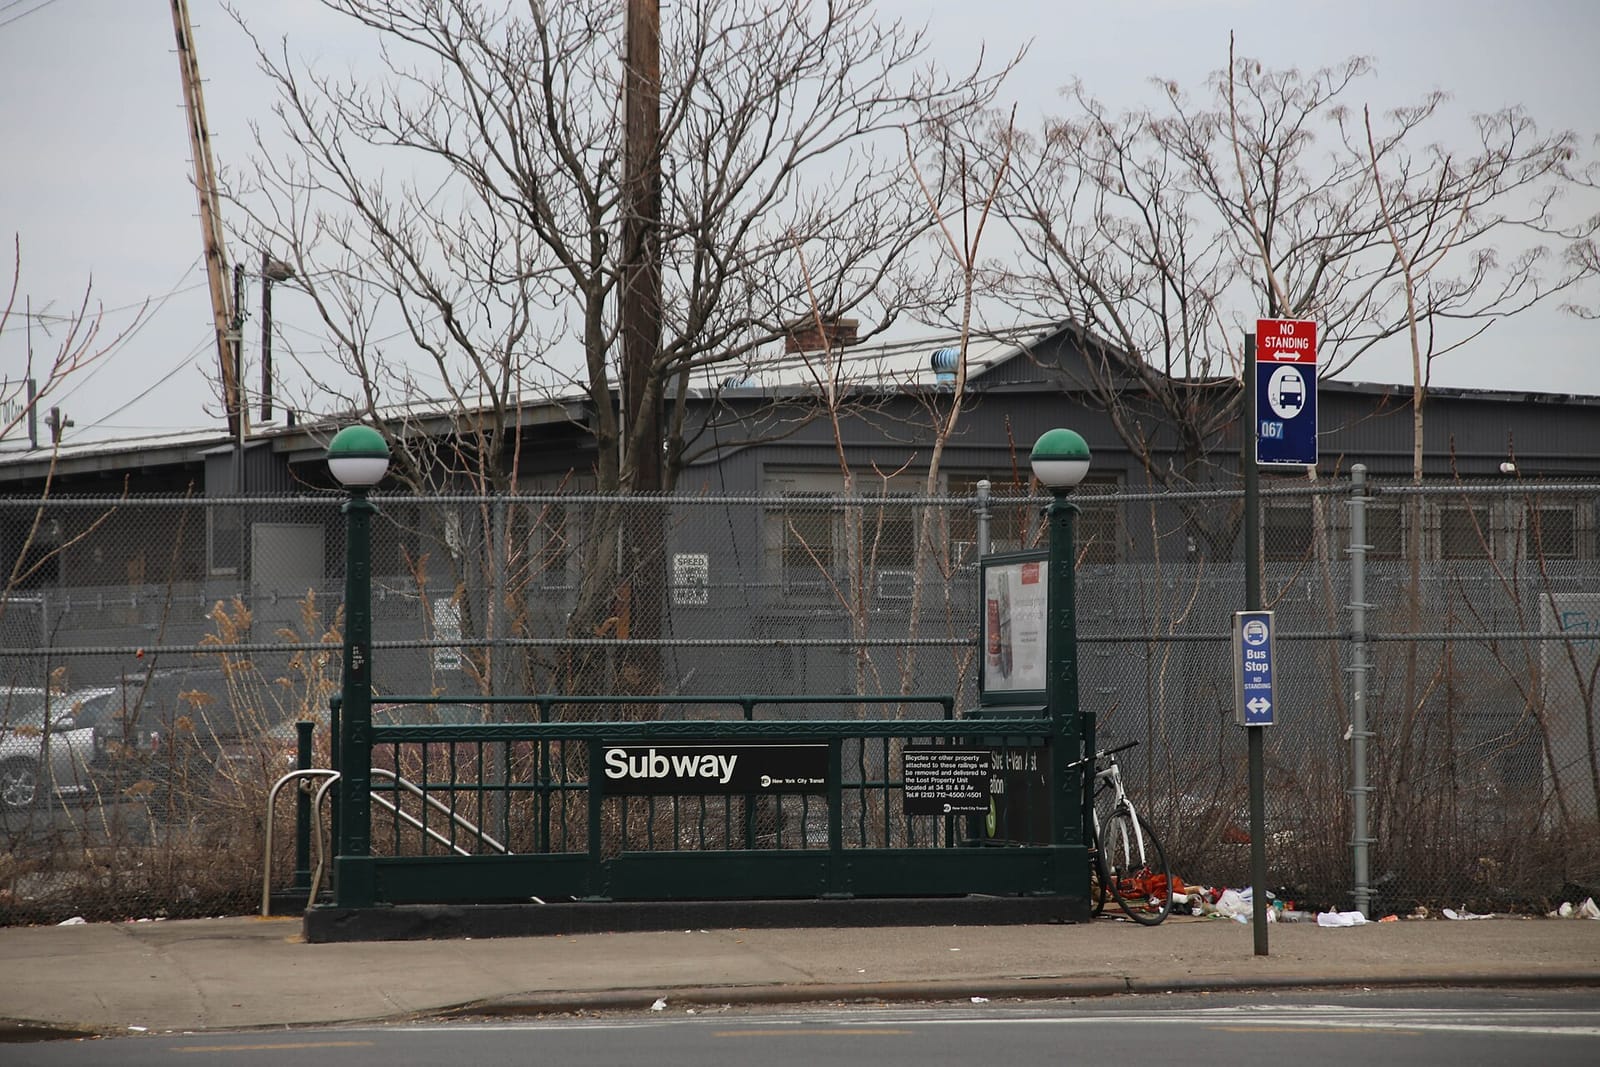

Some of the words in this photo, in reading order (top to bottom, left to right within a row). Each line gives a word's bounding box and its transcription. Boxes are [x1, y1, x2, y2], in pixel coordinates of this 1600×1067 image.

[1279, 323, 1294, 335] NO
[1264, 336, 1309, 349] STANDING
[677, 558, 704, 566] SPEED
[1246, 649, 1266, 659] Bus
[1245, 661, 1269, 673] Stop
[905, 754, 929, 762] Bicycles
[604, 748, 738, 784] Subway
[989, 774, 1004, 794] ation
